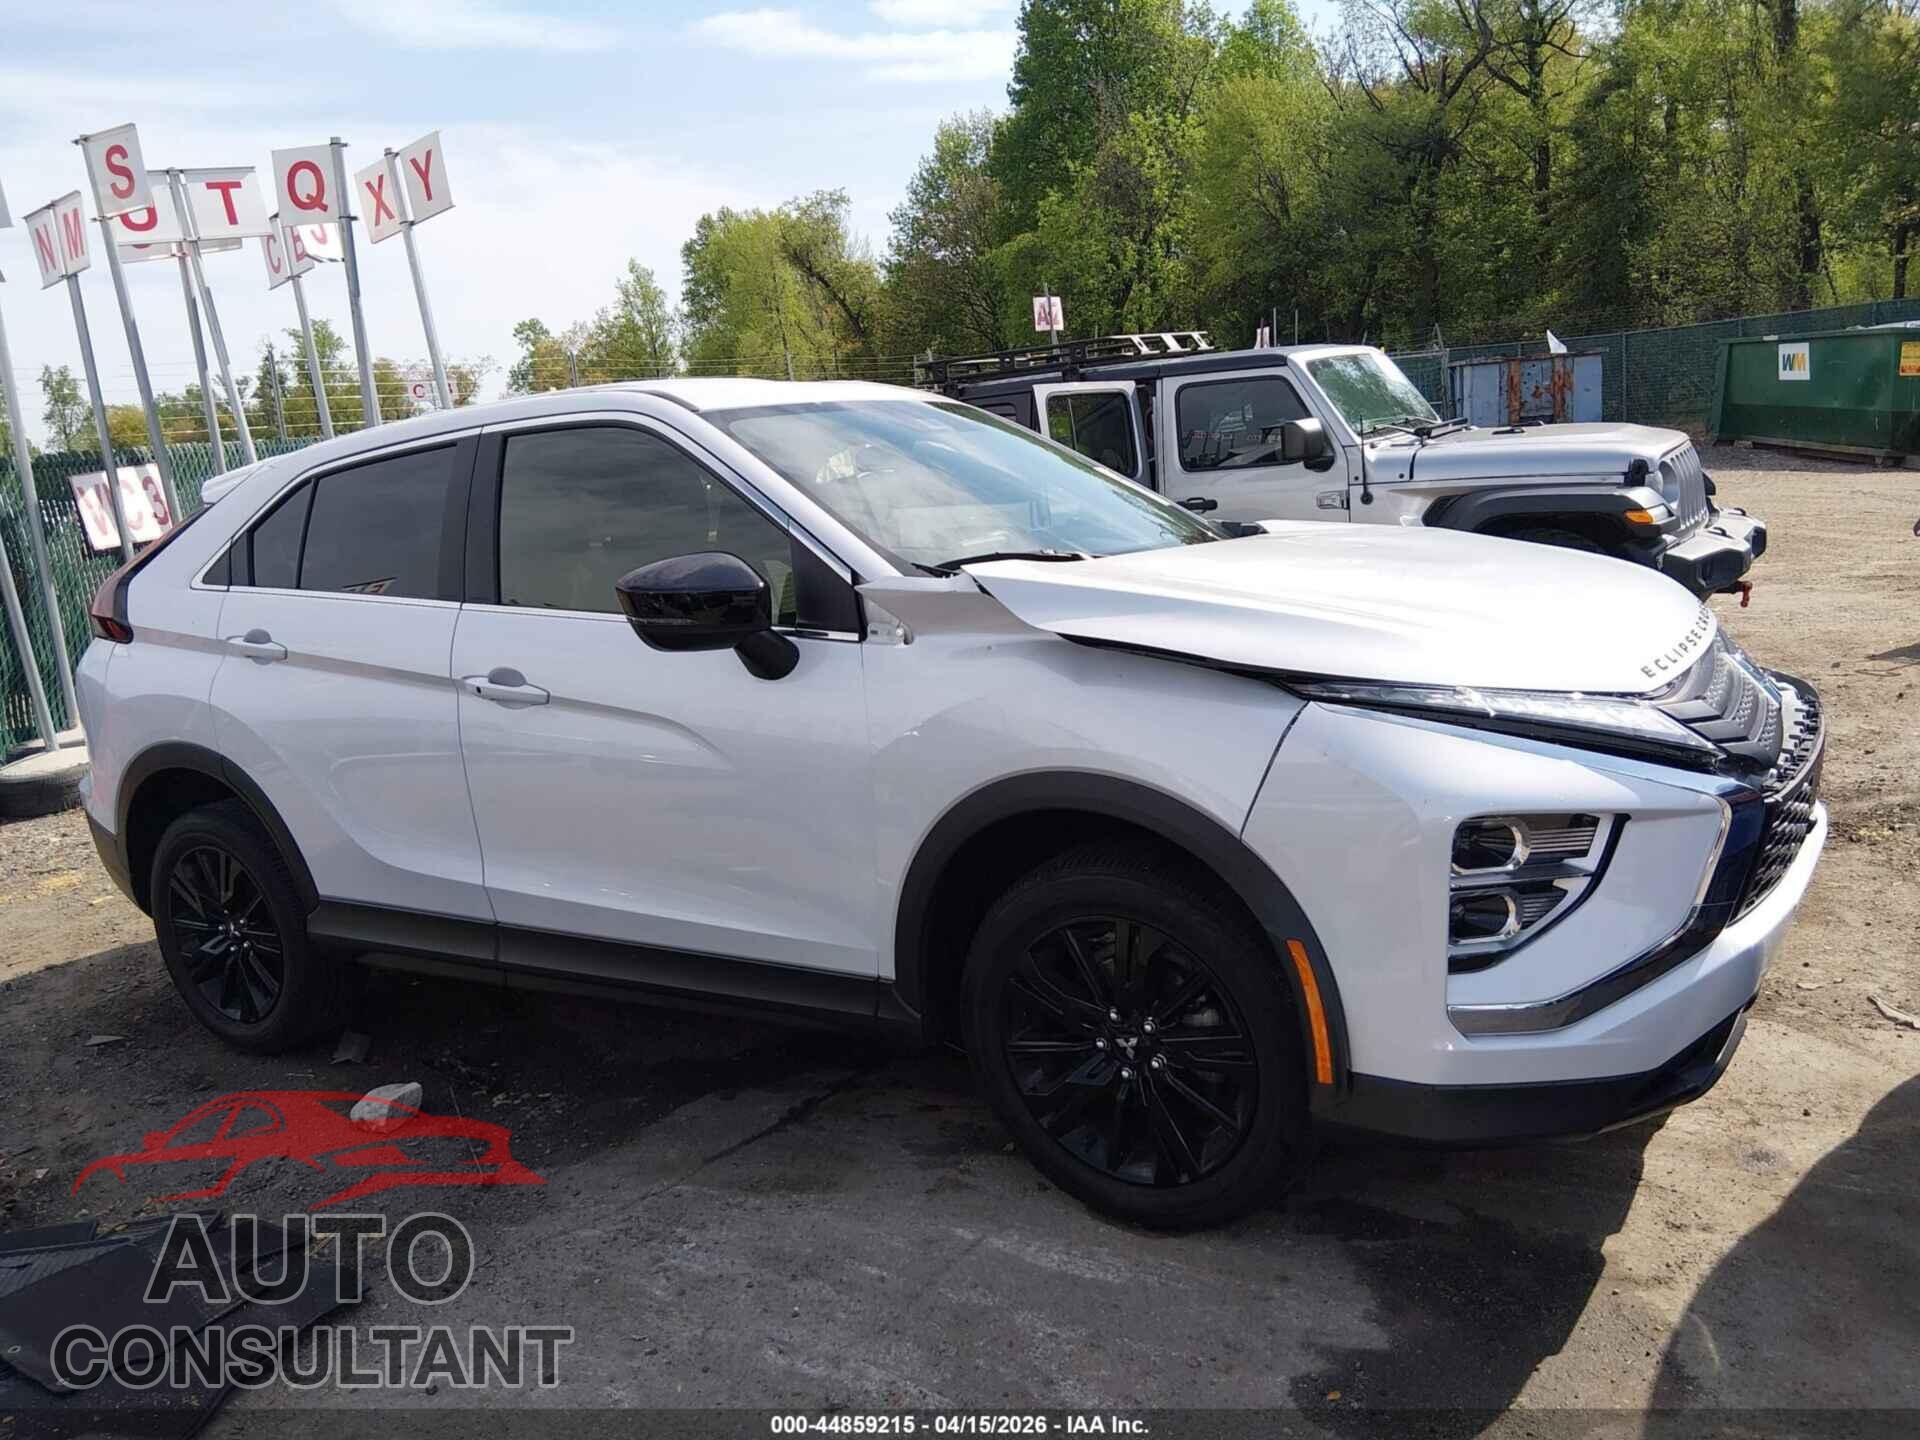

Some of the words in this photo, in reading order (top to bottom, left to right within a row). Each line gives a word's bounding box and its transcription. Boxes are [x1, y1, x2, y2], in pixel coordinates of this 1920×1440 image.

[105, 144, 135, 199] S
[287, 160, 328, 212] Q
[409, 149, 433, 202] Y
[205, 181, 242, 225] T
[365, 174, 395, 226] X
[35, 223, 57, 272] N
[63, 207, 85, 260] M
[1782, 353, 1806, 371] WM
[1640, 629, 1702, 678] ECLIPSE
